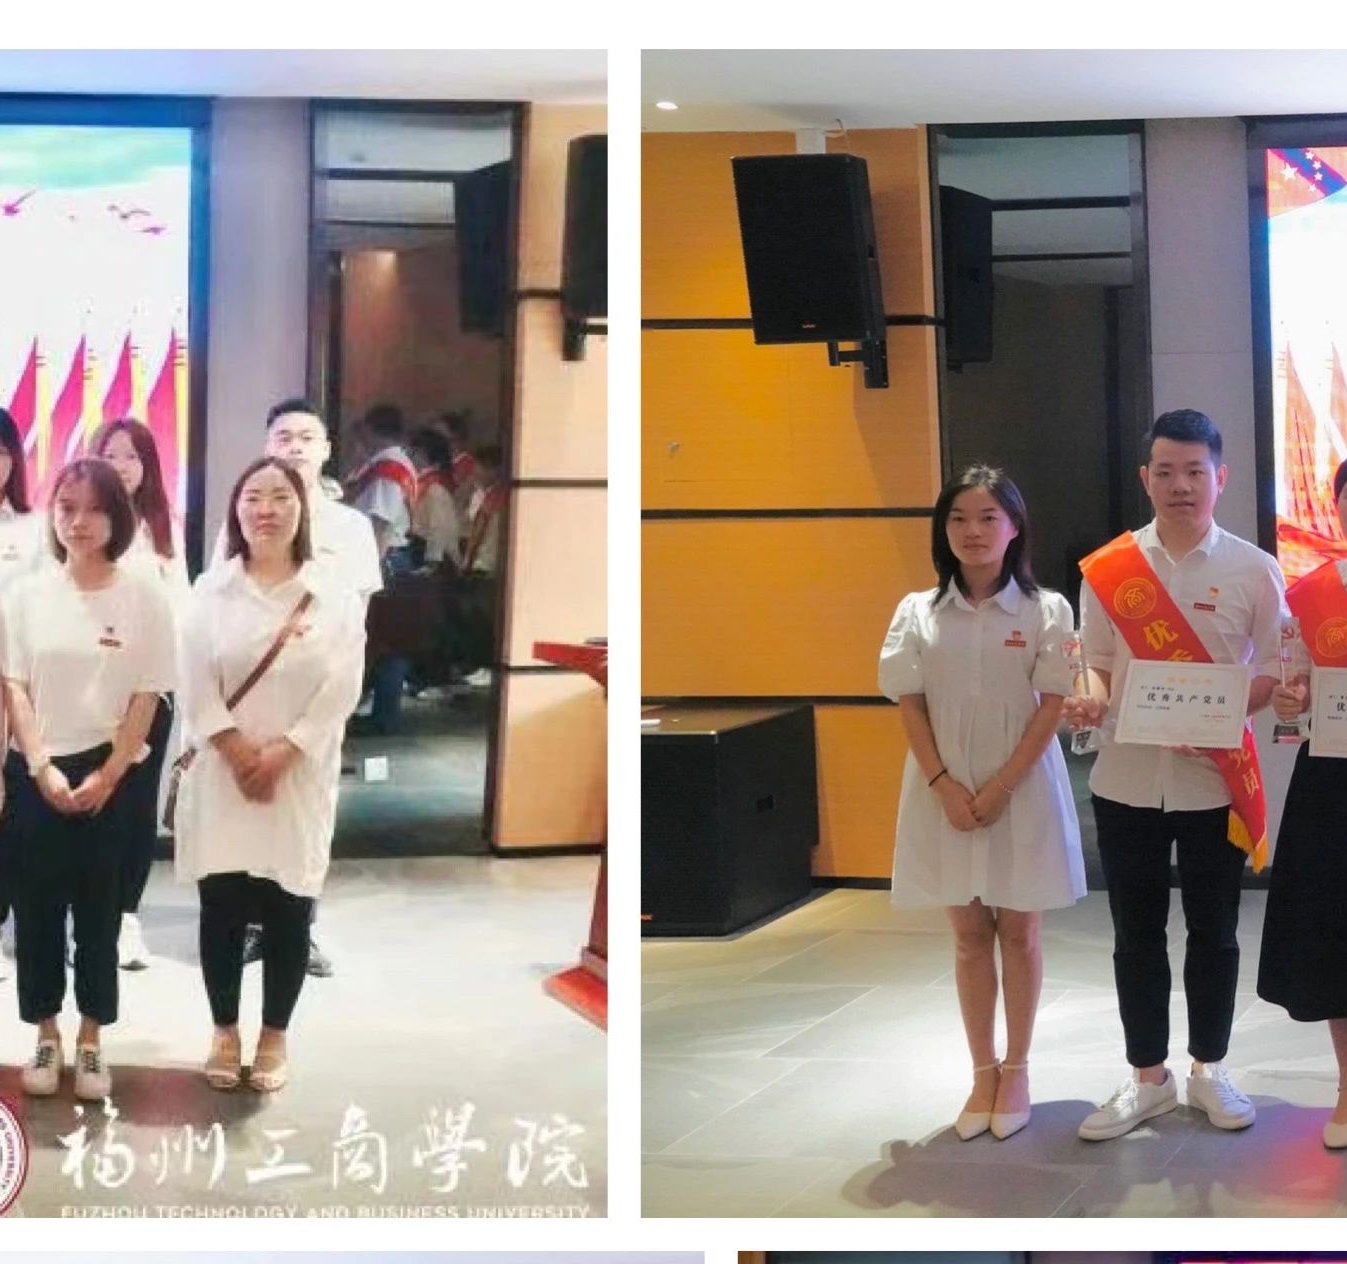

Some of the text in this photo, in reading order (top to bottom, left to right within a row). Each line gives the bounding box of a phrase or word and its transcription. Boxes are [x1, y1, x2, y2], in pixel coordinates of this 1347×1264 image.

[1146, 692, 1226, 705] 优秀共产党员
